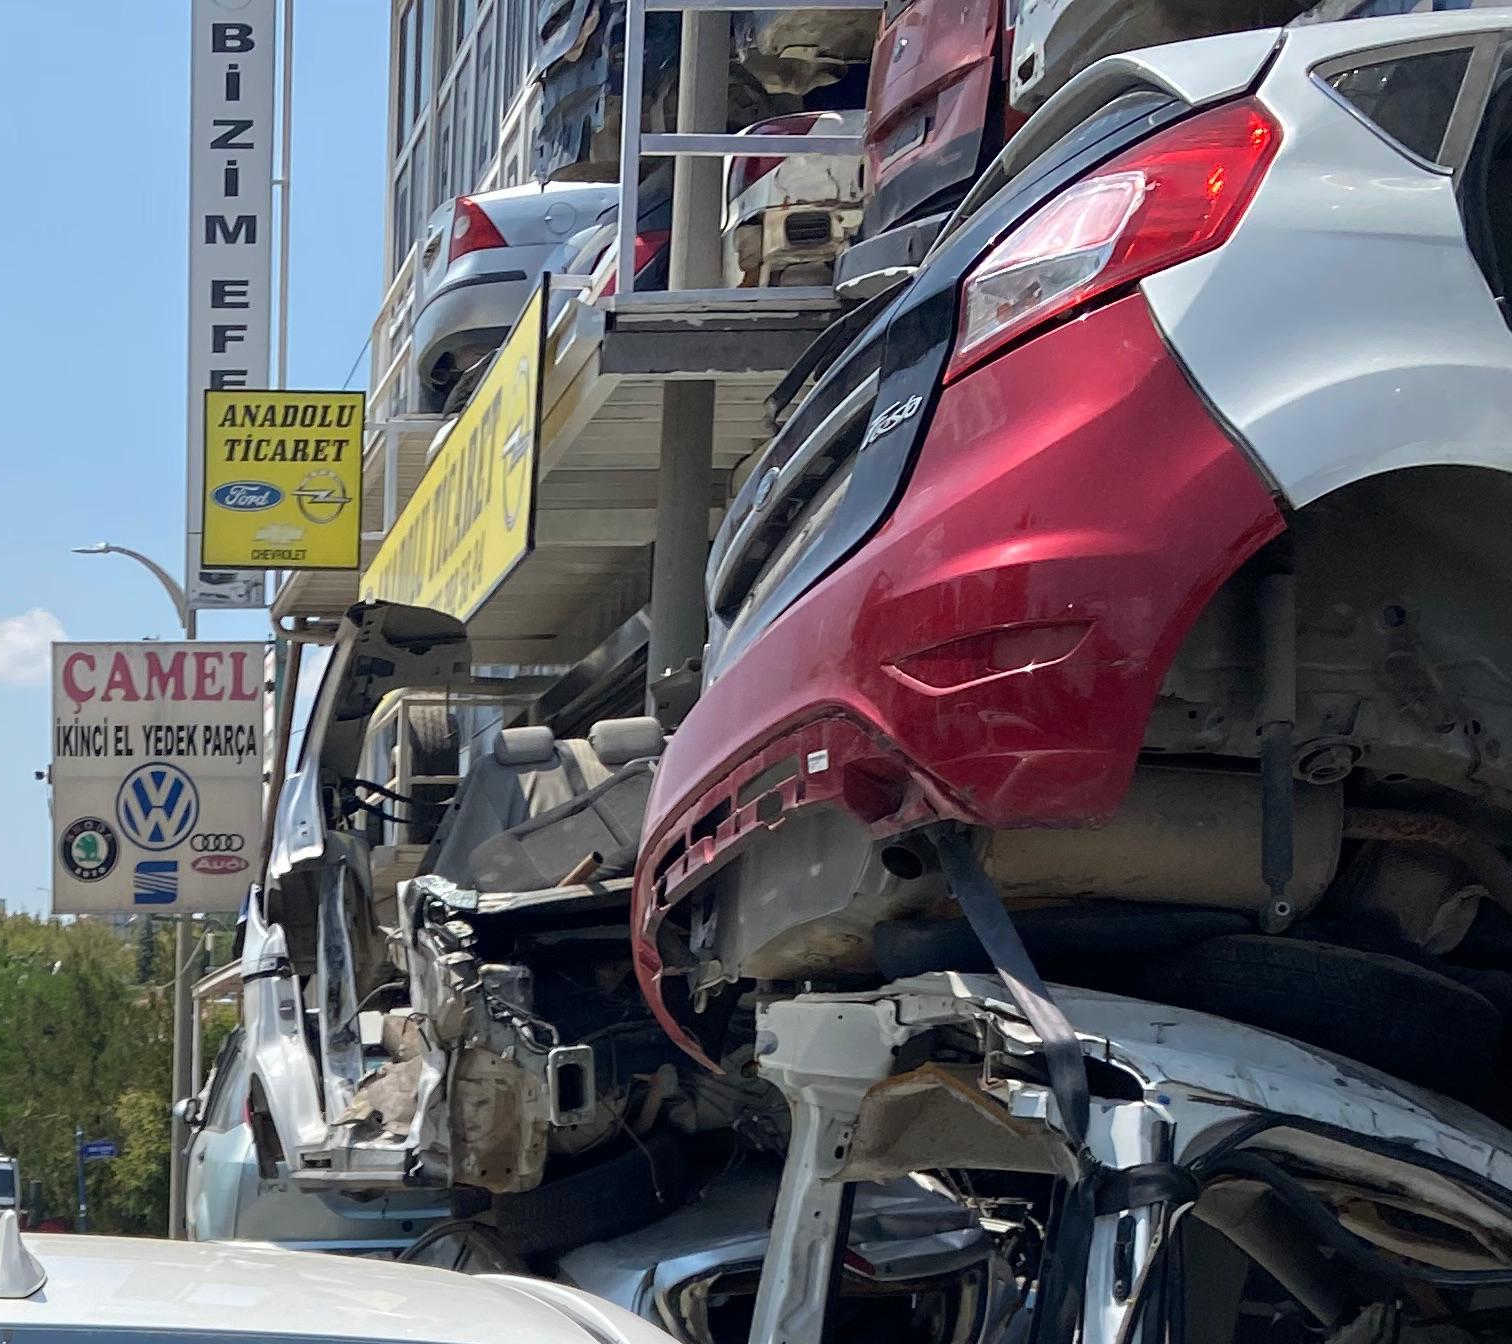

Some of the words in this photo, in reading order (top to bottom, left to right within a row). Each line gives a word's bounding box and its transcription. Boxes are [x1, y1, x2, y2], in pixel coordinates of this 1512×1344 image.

[204, 23, 257, 244] BİZİM
[218, 404, 356, 428] ANADOLU
[224, 434, 349, 462] TİCARET
[225, 485, 271, 506] Ford
[251, 549, 307, 560] CHEVROLET
[62, 651, 259, 714] ÇAMEL
[56, 717, 108, 757] İKİNCİ
[114, 725, 134, 756] EL
[142, 724, 199, 757] YEDEK
[203, 724, 257, 765] PARÇA
